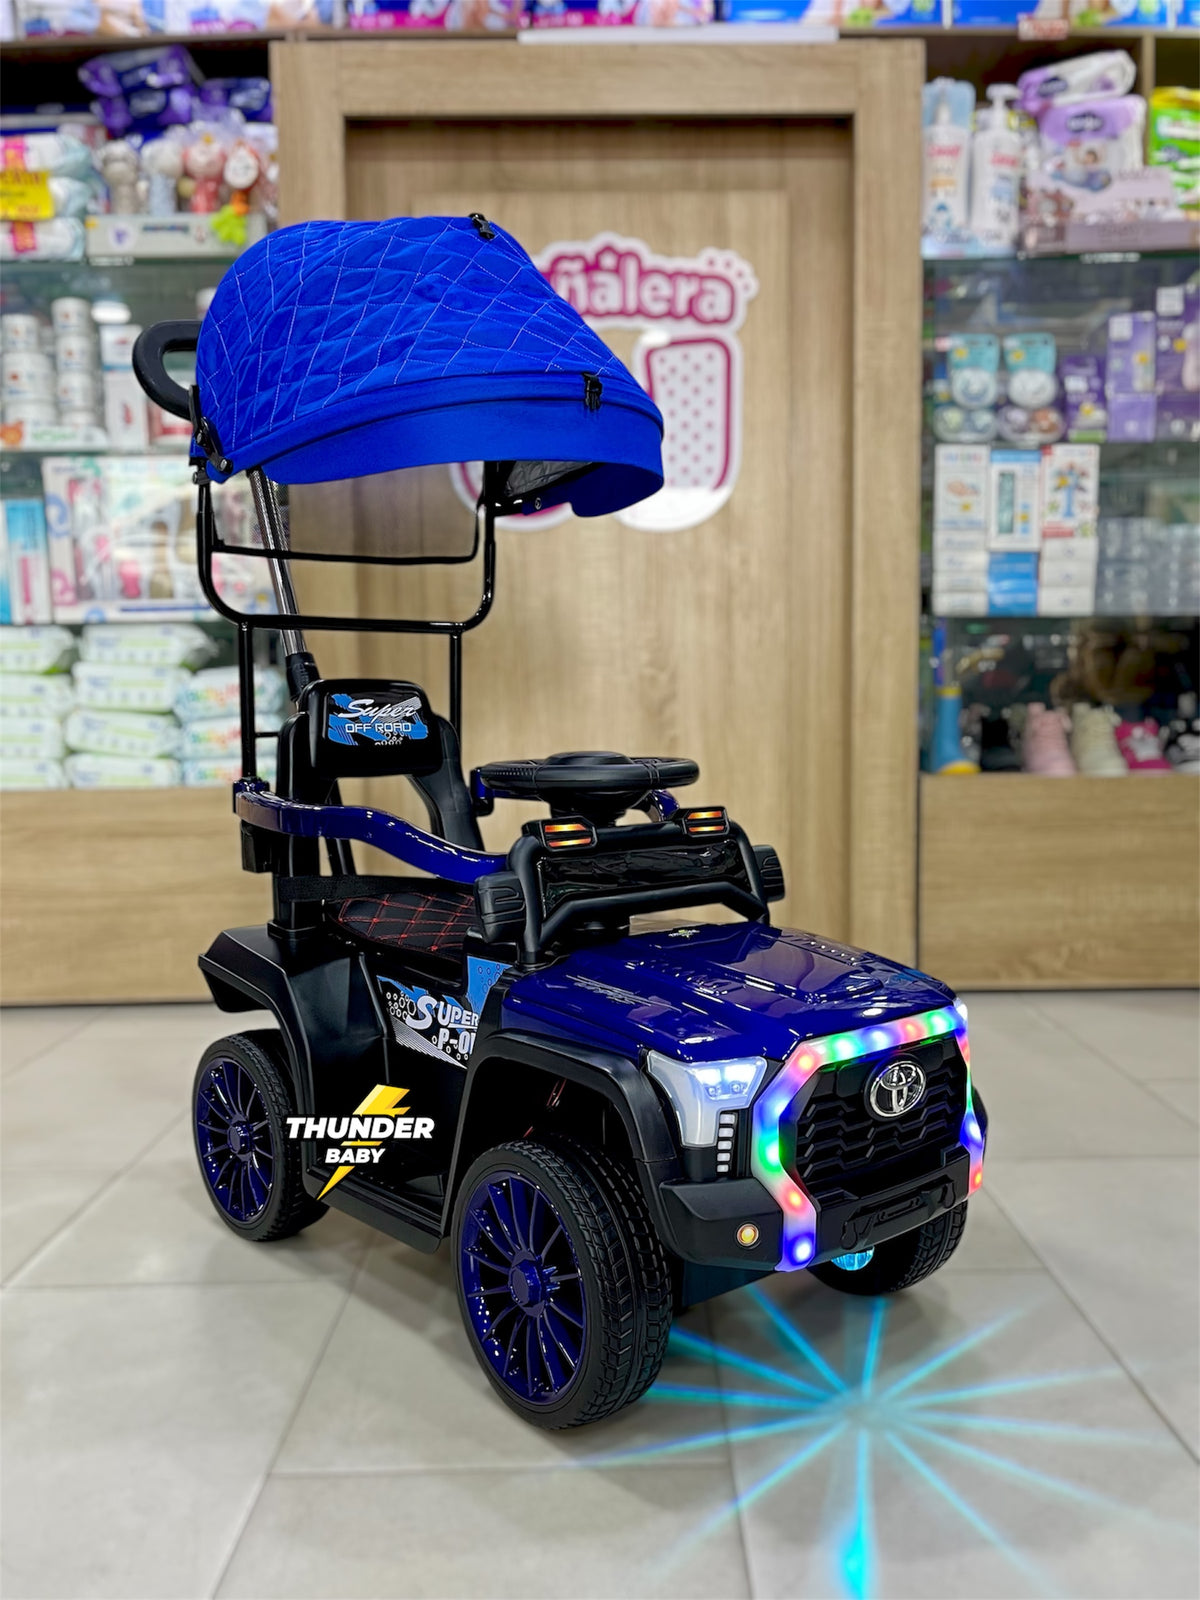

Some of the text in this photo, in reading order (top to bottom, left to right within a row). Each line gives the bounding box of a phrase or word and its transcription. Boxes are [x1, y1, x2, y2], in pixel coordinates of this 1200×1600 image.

[338, 698, 416, 723] Super
[345, 722, 412, 733] OFF ROAD
